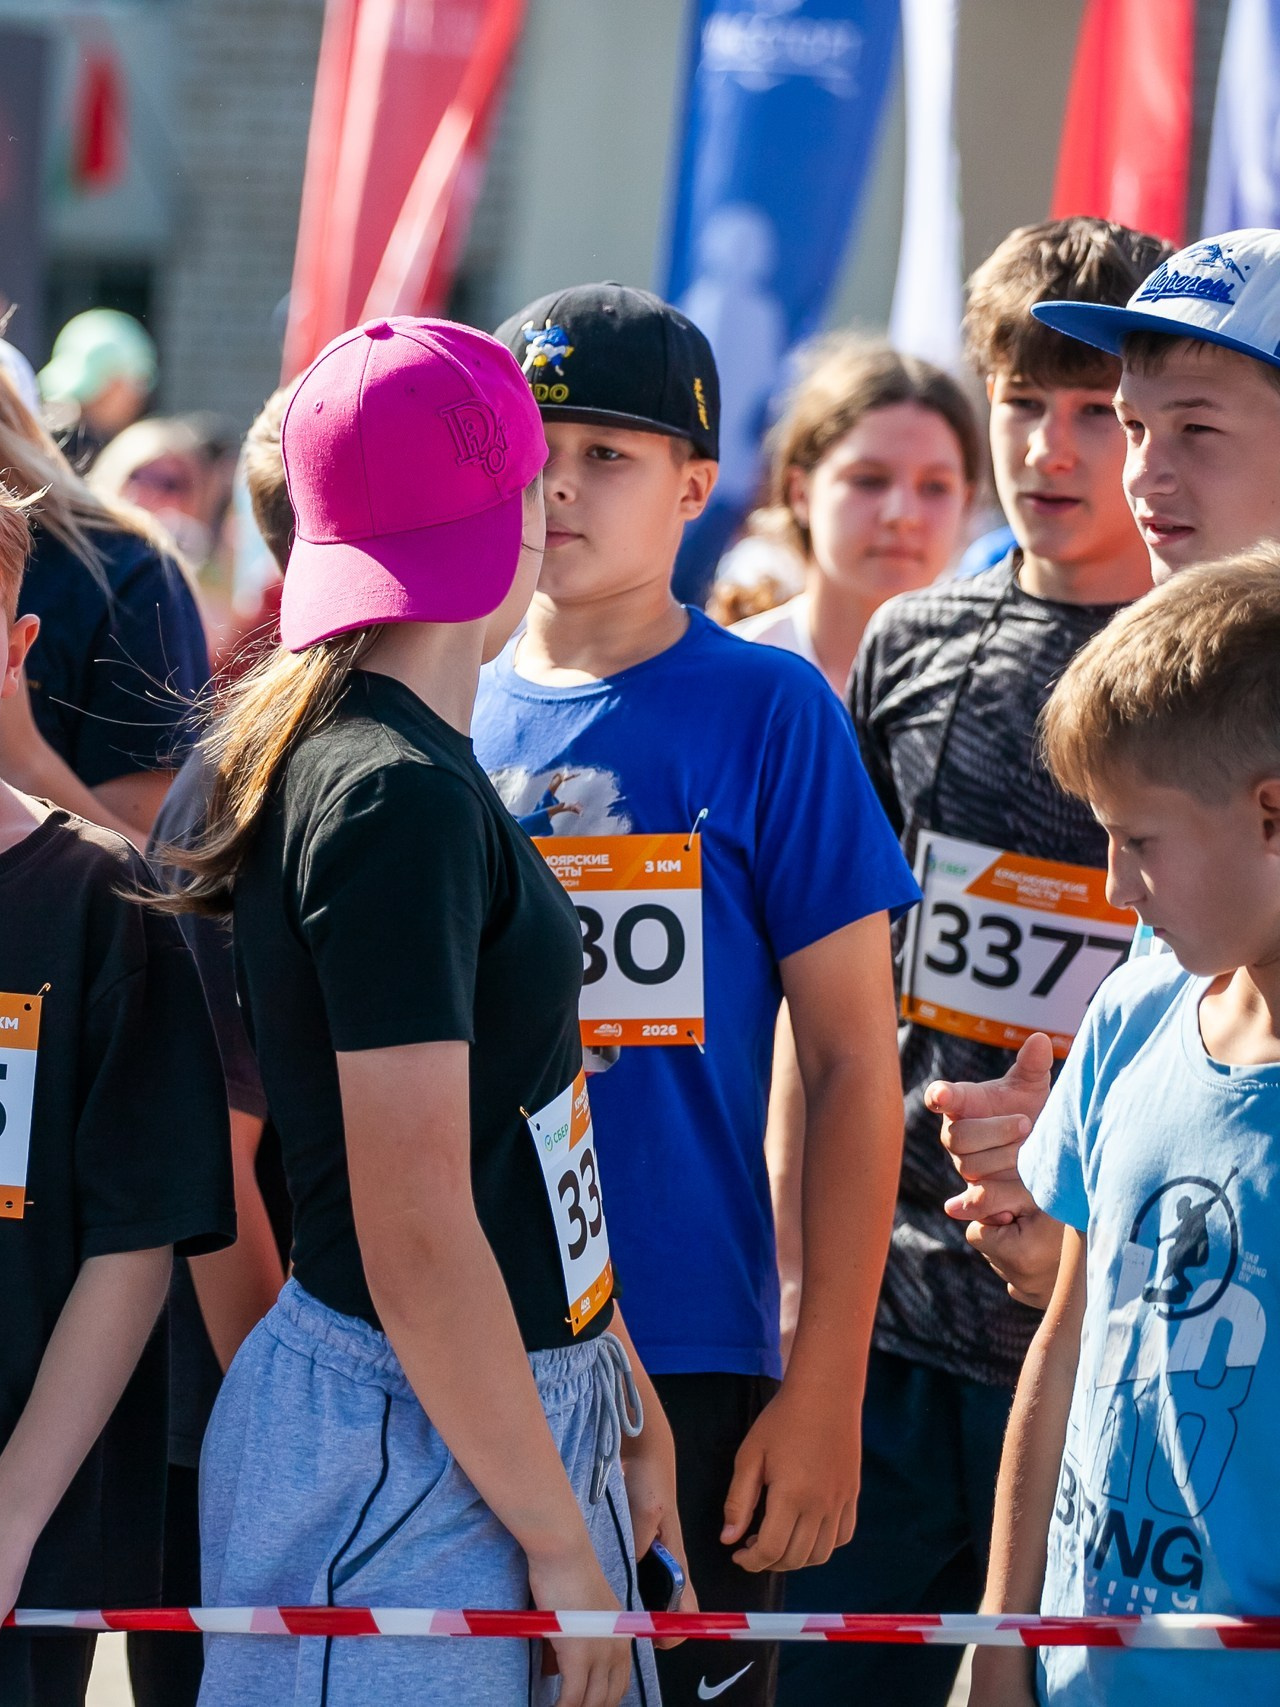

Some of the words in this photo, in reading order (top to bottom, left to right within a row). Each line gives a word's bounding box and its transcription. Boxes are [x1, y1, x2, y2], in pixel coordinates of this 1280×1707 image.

[529, 383, 569, 403] DO
[644, 860, 654, 873] 3
[656, 859, 682, 873] КМ
[925, 901, 1132, 1005] 3377
[642, 1025, 678, 1037] 2026
[553, 1123, 569, 1143] СБЕР
[557, 1148, 602, 1261] 33
